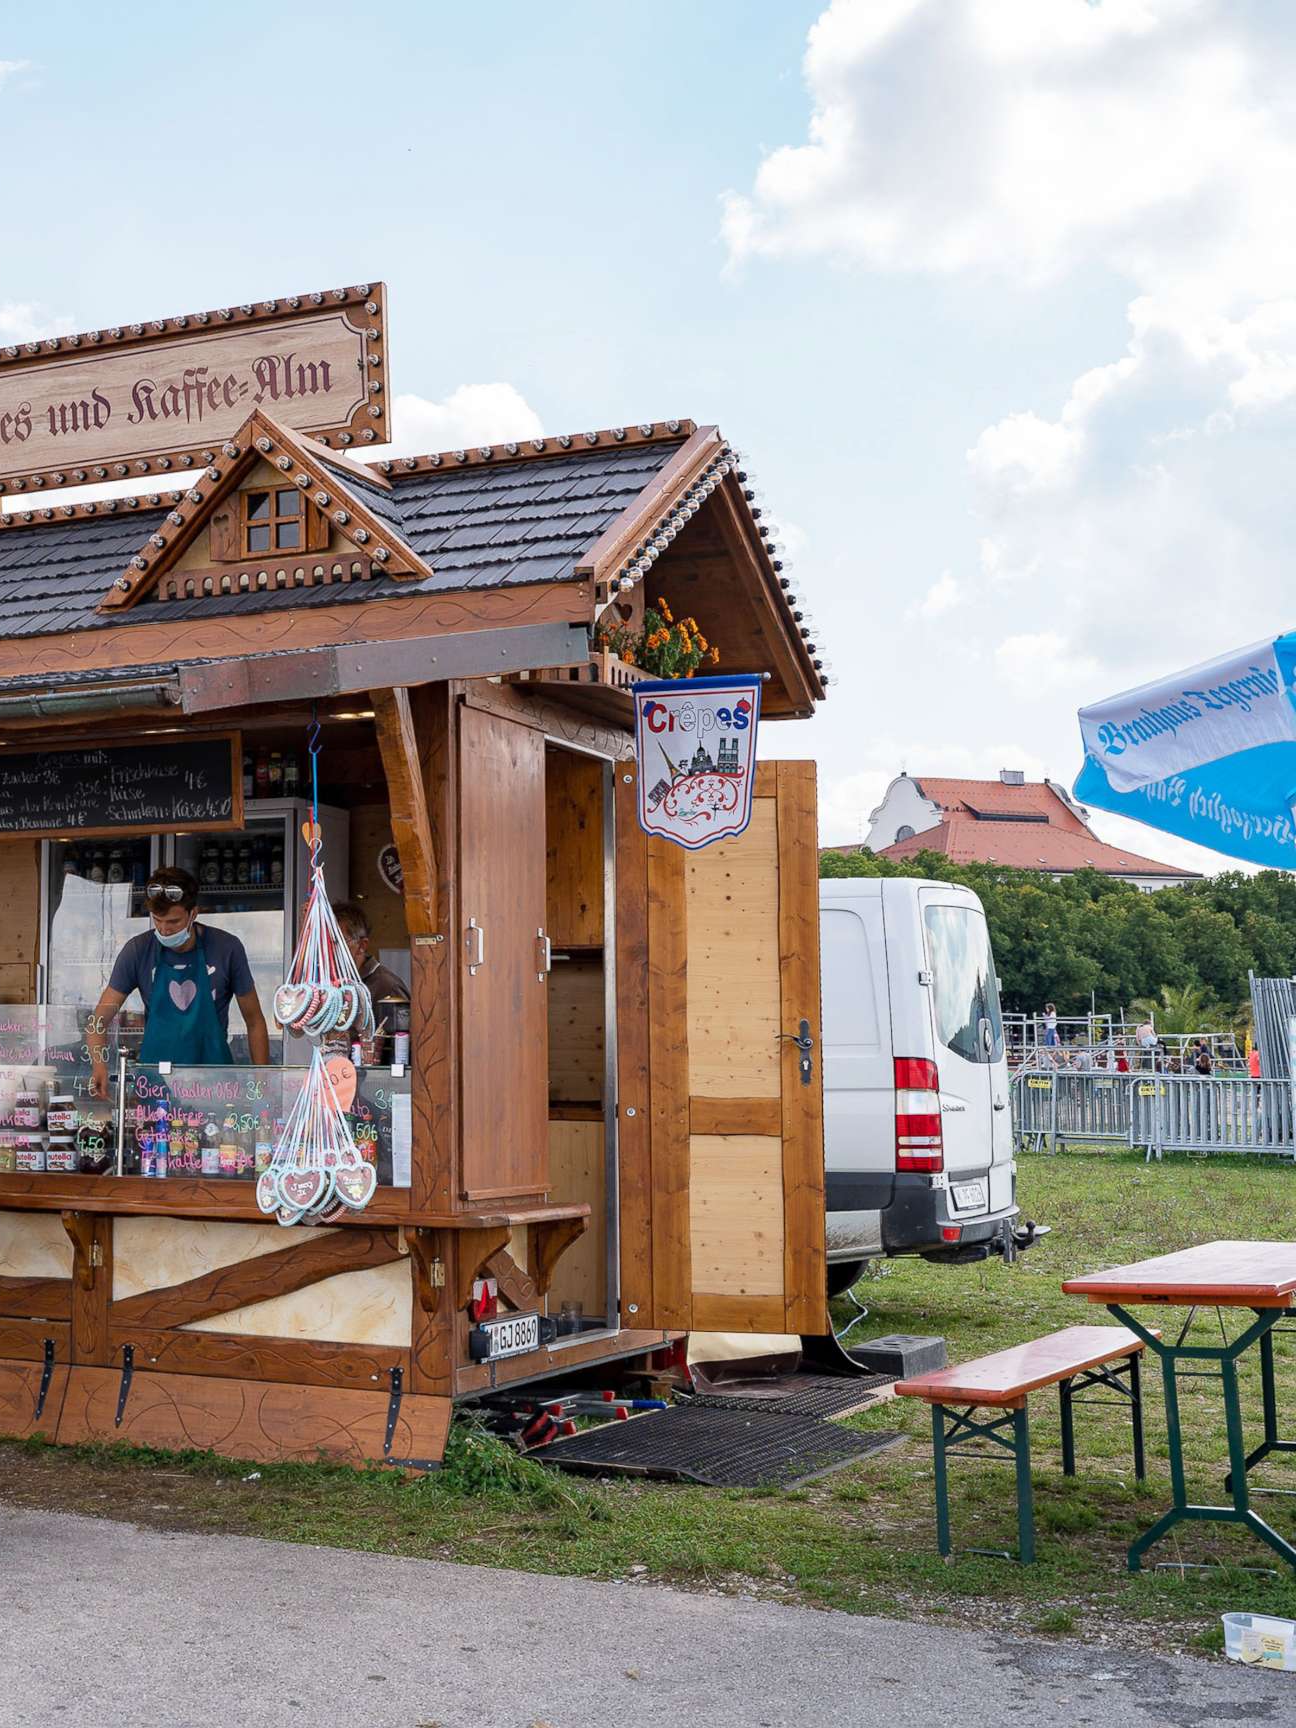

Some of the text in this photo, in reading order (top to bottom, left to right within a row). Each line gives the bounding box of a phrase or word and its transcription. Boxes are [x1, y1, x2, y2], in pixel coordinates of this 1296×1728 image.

[48, 388, 112, 436] und
[646, 701, 750, 739] Crêpes
[1097, 697, 1202, 756] Brauhaus
[500, 1325, 513, 1351] GJ
[514, 1319, 537, 1348] 8869
